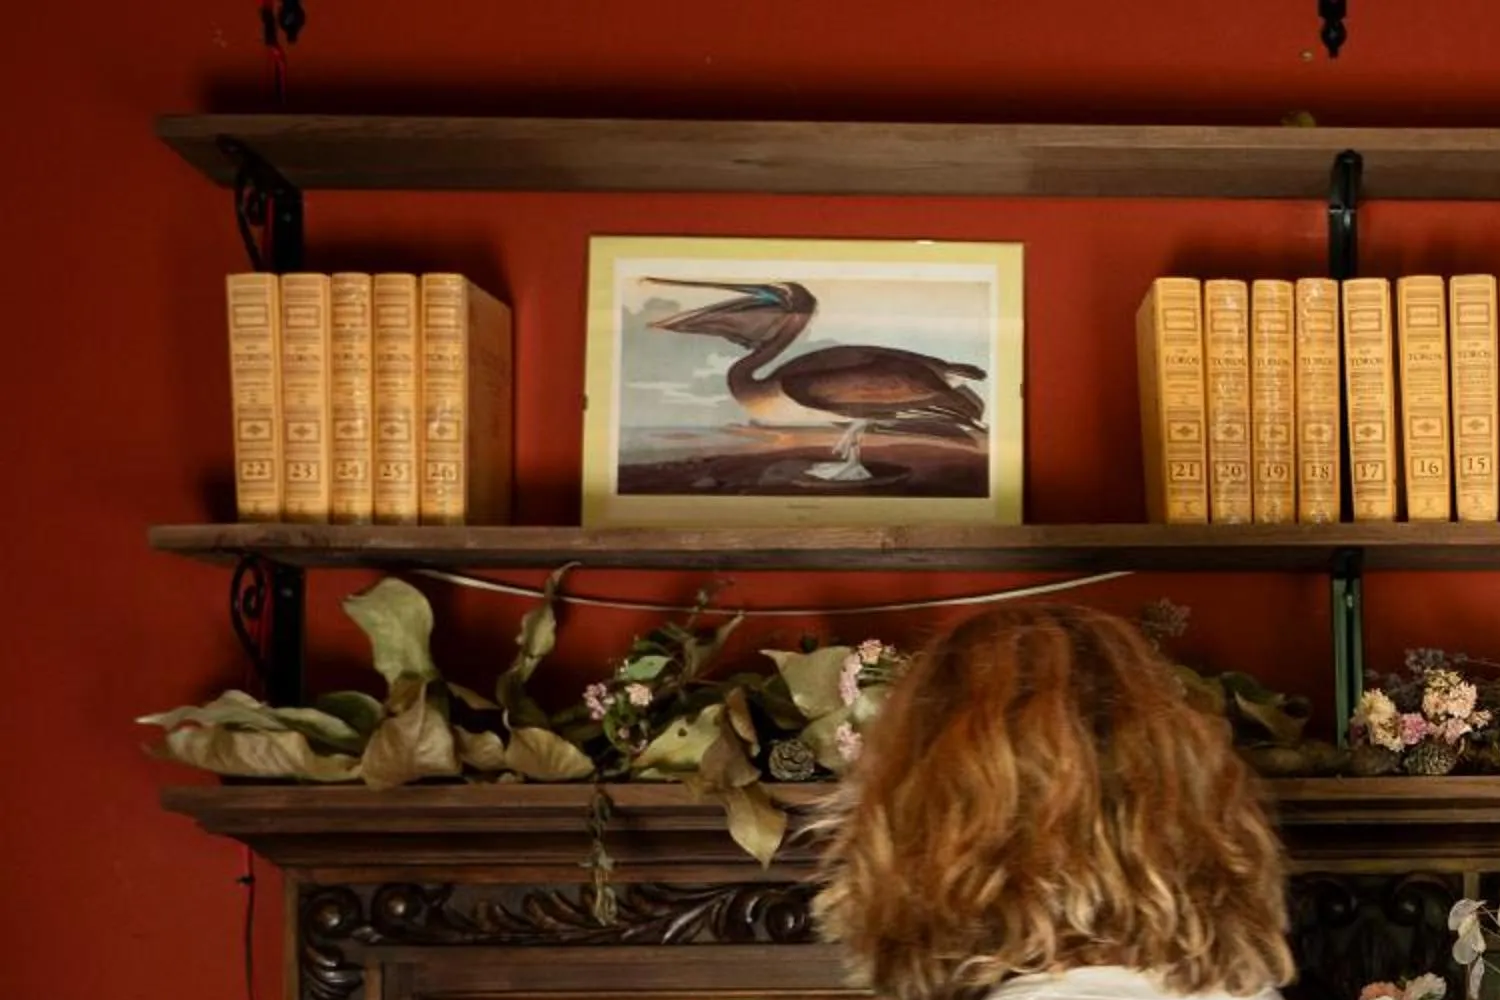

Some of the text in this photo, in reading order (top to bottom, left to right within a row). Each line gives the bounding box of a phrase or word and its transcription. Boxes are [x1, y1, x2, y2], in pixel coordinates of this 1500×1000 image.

[245, 463, 266, 476] 22
[382, 463, 404, 478] 25
[1175, 463, 1195, 477] 21
[1419, 459, 1439, 475] 16
[1466, 457, 1485, 471] 15
[291, 464, 312, 479] 23
[1221, 465, 1242, 478] 20
[1264, 465, 1285, 479] 19
[1310, 465, 1330, 480] 18
[1359, 464, 1379, 479] 17
